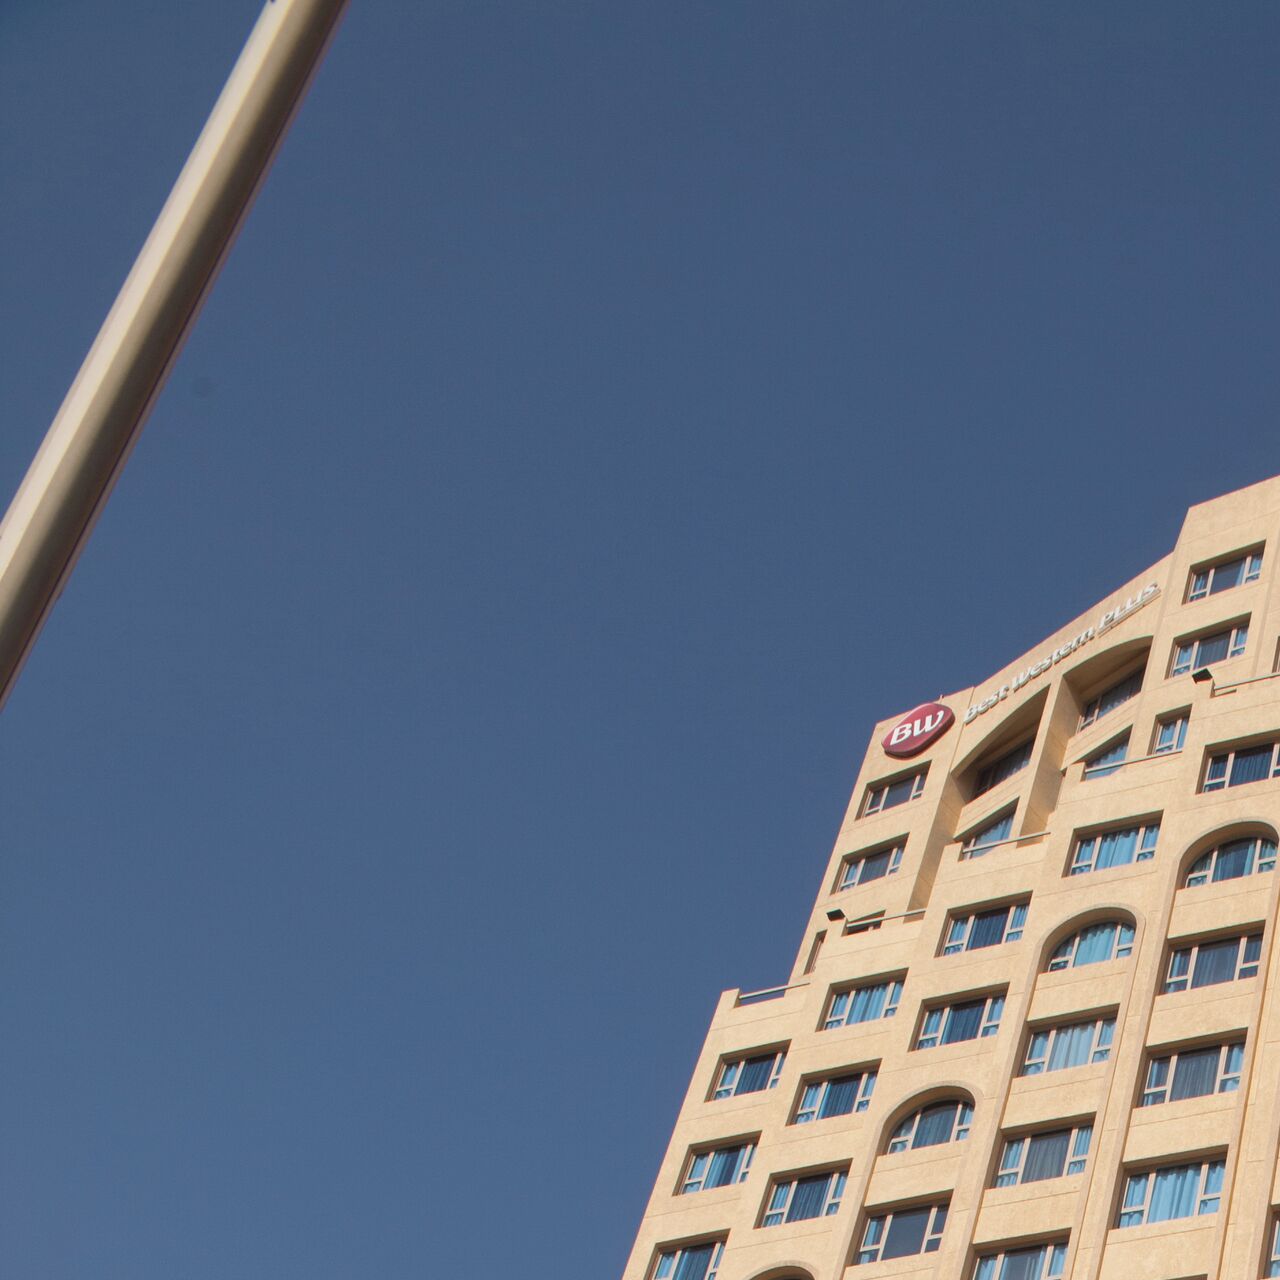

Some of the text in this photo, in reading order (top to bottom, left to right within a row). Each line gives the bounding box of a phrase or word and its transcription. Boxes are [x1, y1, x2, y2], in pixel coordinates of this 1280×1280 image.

[963, 581, 1160, 725] Best Western PLUS
[889, 709, 945, 746] BW
